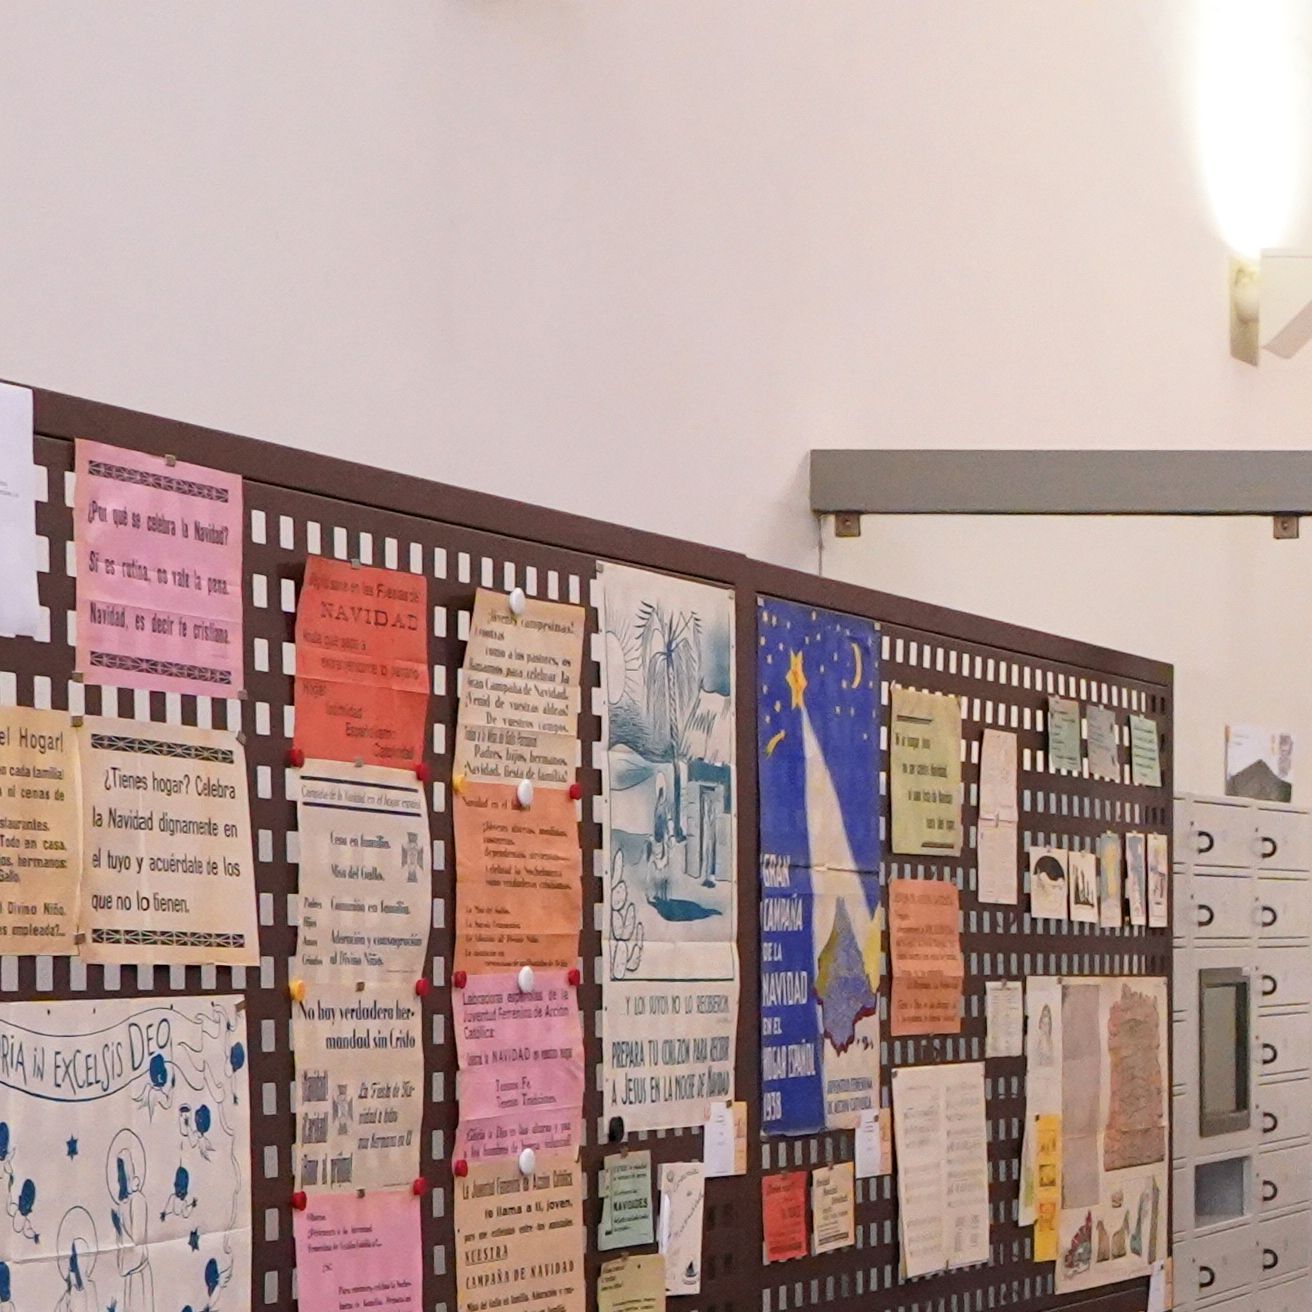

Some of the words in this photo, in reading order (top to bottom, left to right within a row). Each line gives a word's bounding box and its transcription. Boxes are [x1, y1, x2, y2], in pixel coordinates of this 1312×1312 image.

[113, 506, 127, 529] qué
[132, 512, 140, 529] se
[147, 513, 175, 536] celebra
[181, 517, 188, 538] la
[194, 521, 228, 545] Navidad?
[105, 559, 115, 575] es
[172, 568, 189, 589] vale
[90, 602, 128, 629] Navidad,
[135, 614, 145, 630] es
[151, 613, 174, 636] decir
[321, 602, 418, 630] NAVIDAD
[19, 728, 64, 754] Hogar!
[10, 765, 30, 778] cada
[104, 767, 148, 790] ¿Tienes
[152, 771, 190, 796] hogar?
[195, 775, 236, 799] Celebra
[21, 788, 49, 800] cenas
[54, 788, 64, 801] de
[92, 806, 102, 827] la
[108, 808, 152, 831] Navidad
[159, 813, 218, 838] dignamente
[224, 823, 237, 838] en
[25, 838, 37, 849] en
[92, 848, 101, 868] el
[107, 850, 130, 874] tuyo
[136, 855, 143, 874] y
[150, 852, 203, 875] acuérdate
[207, 856, 218, 875] de
[223, 856, 240, 877] los
[762, 854, 791, 888] GRAN
[92, 893, 112, 912] que
[116, 894, 132, 911] no
[137, 891, 150, 911] lo
[153, 893, 189, 914] tienen.
[762, 893, 802, 932] CAMPAÑA
[763, 944, 773, 962] DE
[774, 943, 782, 961] LA
[762, 971, 808, 1007] NAVIDAD
[300, 1001, 315, 1020] No
[318, 1000, 335, 1026] hay
[339, 1000, 394, 1021] verdadero
[395, 1000, 415, 1021] her-
[128, 1018, 170, 1071] DEO
[326, 1028, 370, 1050] mandad
[373, 1030, 388, 1049] sin
[390, 1028, 415, 1048] Cristo
[612, 1040, 645, 1069] PREPARA
[648, 1040, 658, 1066] TU
[693, 1038, 708, 1063] PARA
[492, 1048, 530, 1063] NAVIDAD
[611, 1079, 617, 1106] A
[650, 1076, 660, 1103] EN
[664, 1076, 672, 1102] LA
[675, 1074, 695, 1100] NOCHE
[485, 1209, 493, 1219] te
[497, 1205, 522, 1217] llama
[527, 1205, 532, 1213] a
[546, 1199, 573, 1212] joven.
[465, 1244, 508, 1264] NUESTRA
[466, 1270, 509, 1290] CAMPAÑA
[514, 1267, 525, 1281] DE
[531, 1260, 574, 1278] NAVIDAD
